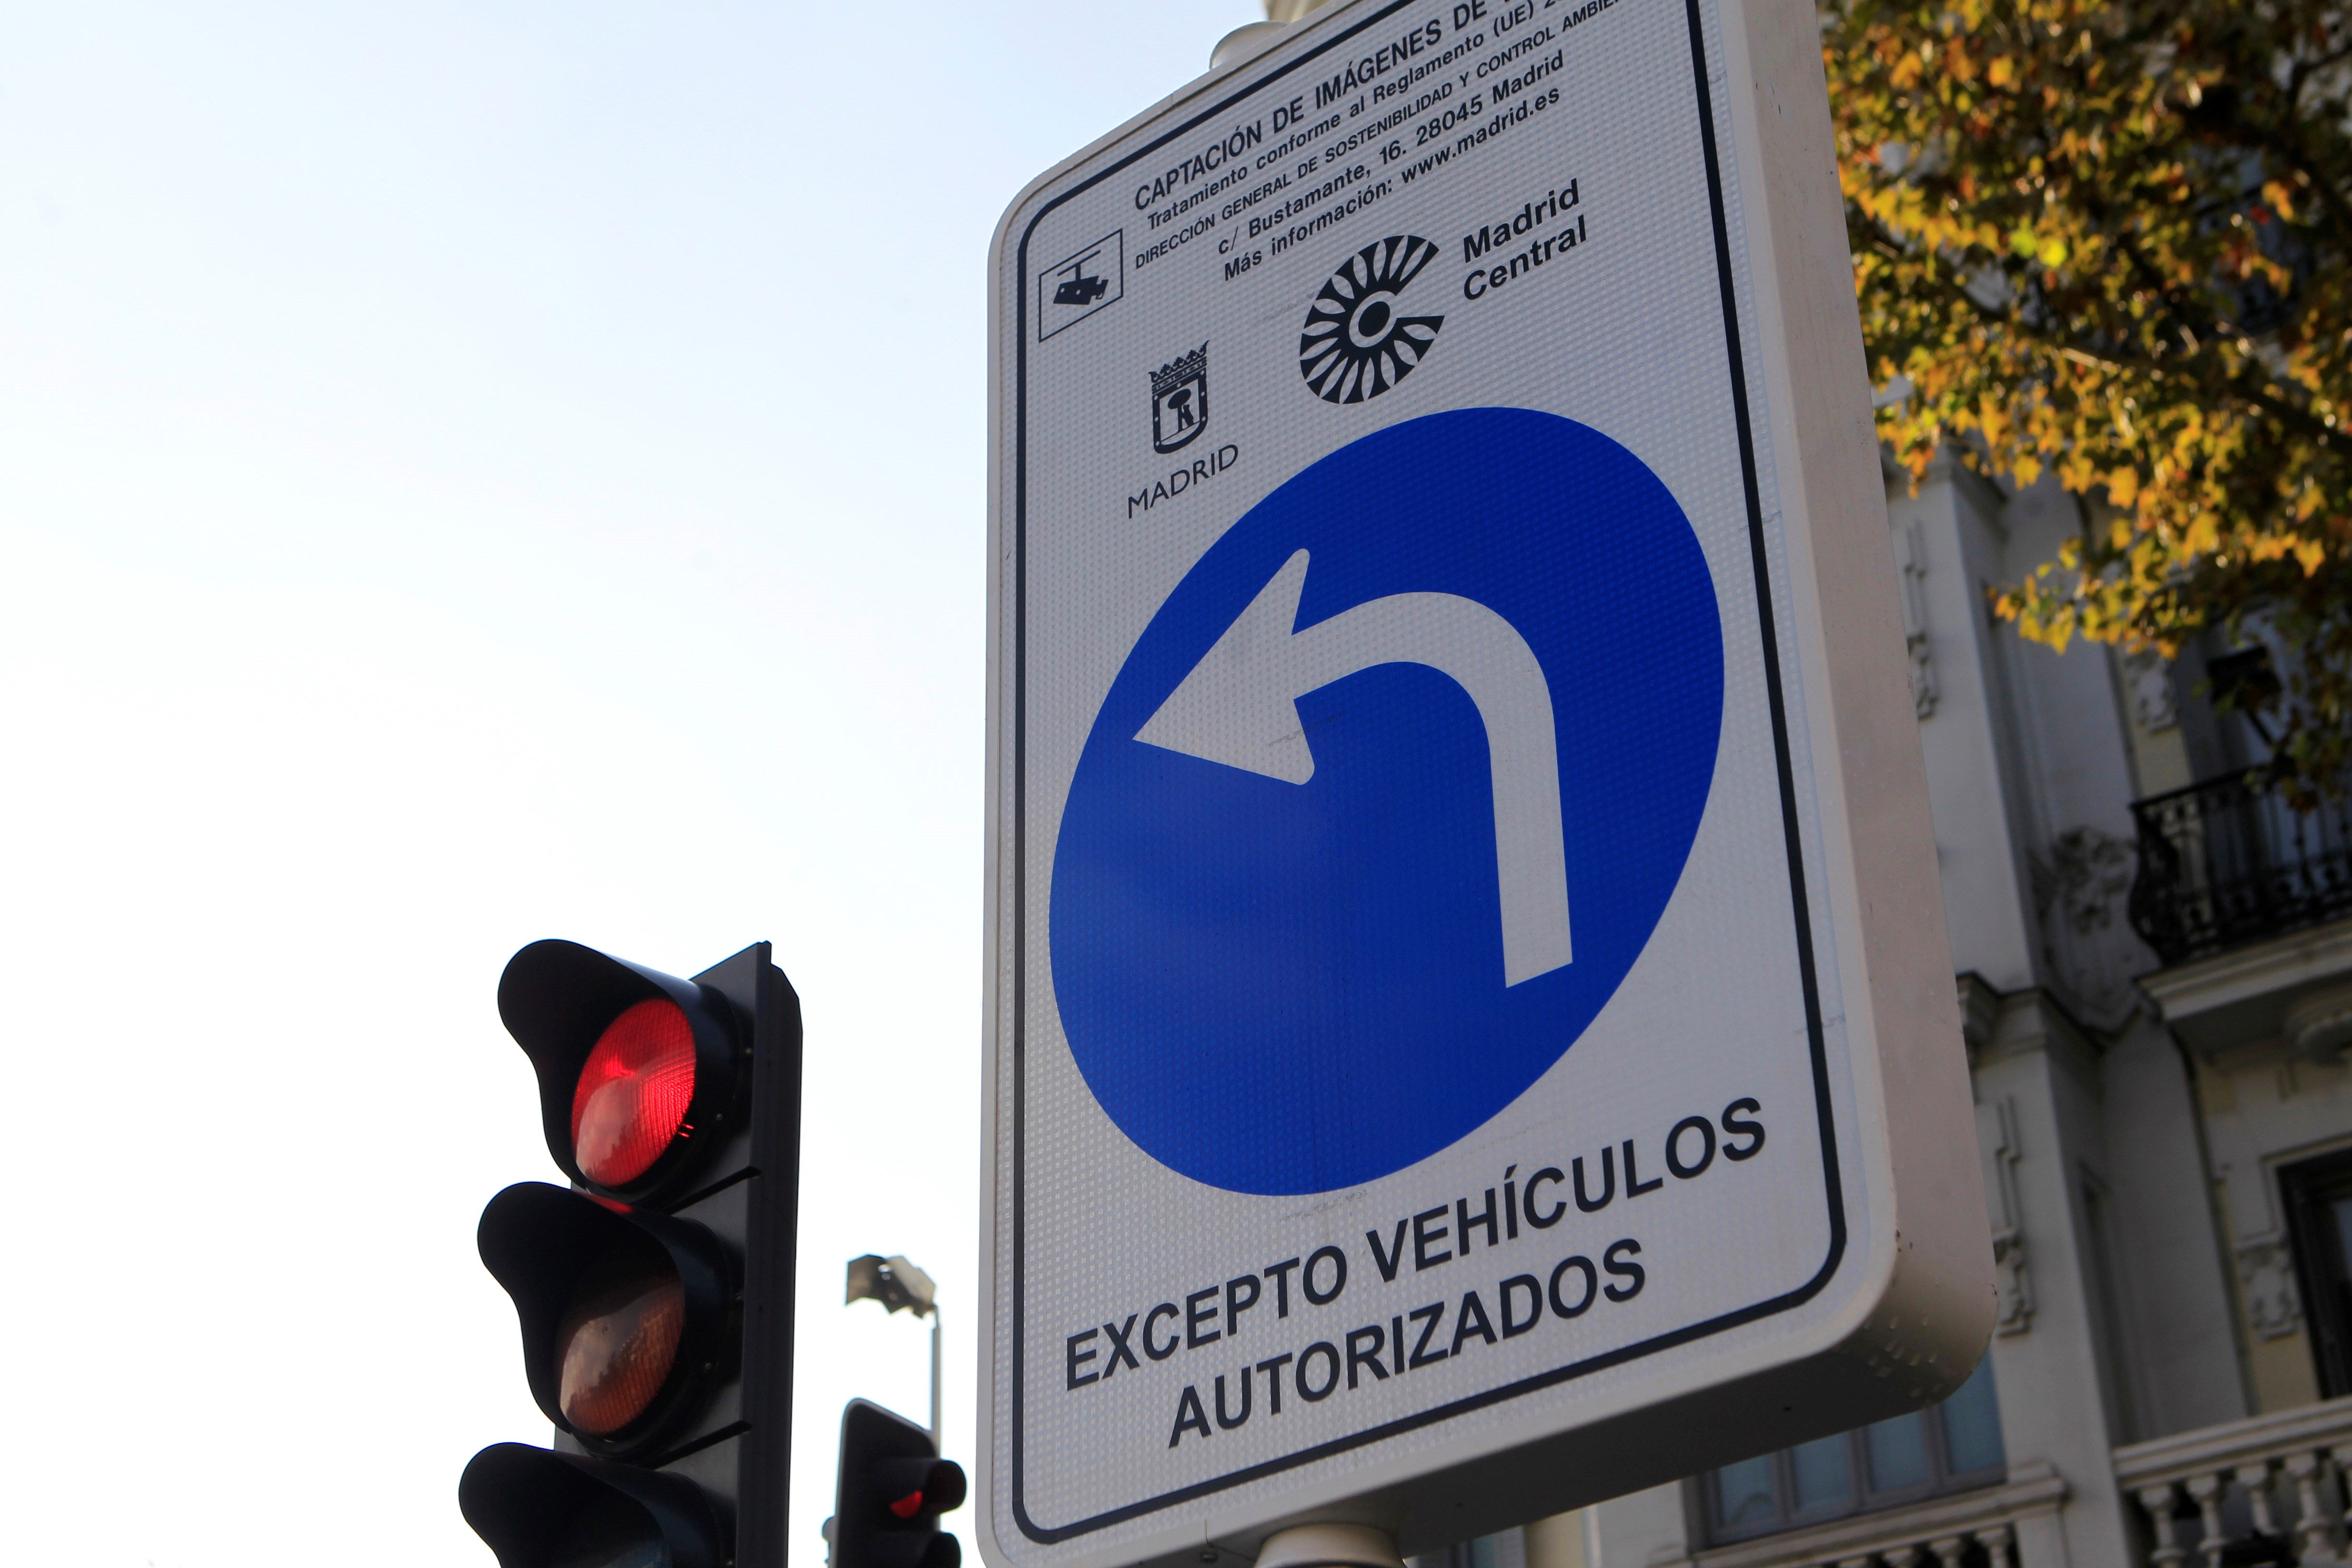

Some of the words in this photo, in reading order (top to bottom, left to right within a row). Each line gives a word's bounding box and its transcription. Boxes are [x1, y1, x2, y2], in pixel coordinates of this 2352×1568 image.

[1135, 125, 1262, 210] CAPTACIÓN
[1273, 96, 1304, 134] DE
[1315, 19, 1442, 110] IMÁGENES
[1453, 0, 1487, 31] DE
[1136, 213, 1215, 270] DIRECCIÓN
[1222, 173, 1292, 220] GENERAL
[1298, 156, 1318, 179] DE
[1325, 82, 1452, 163] SOSTENIBILIDAD
[1459, 71, 1469, 87] Y
[1476, 26, 1556, 78] CONTROL
[1147, 166, 1248, 230] Tratamiento
[1256, 114, 1341, 170] conforme
[1349, 95, 1365, 118] al
[1373, 33, 1484, 105] Reglamento
[1493, 0, 1534, 37] (UE)
[1218, 226, 1238, 255] c/
[1249, 165, 1371, 239] Bustamante,
[1379, 140, 1407, 165] 16.
[1416, 94, 1483, 147] 28045
[1492, 49, 1563, 105] Madrid
[1225, 250, 1262, 282] Más
[1272, 179, 1392, 256] información:
[1401, 88, 1559, 184] www.madrid.es
[1463, 178, 1579, 264] Madrid
[1464, 214, 1587, 300] Central
[1128, 444, 1238, 519] MADRID
[1066, 1245, 1348, 1391] EXCEPTO
[1366, 1097, 1766, 1283] VEHÍCULOS
[1168, 1238, 1646, 1449] AUTORIZADOS
